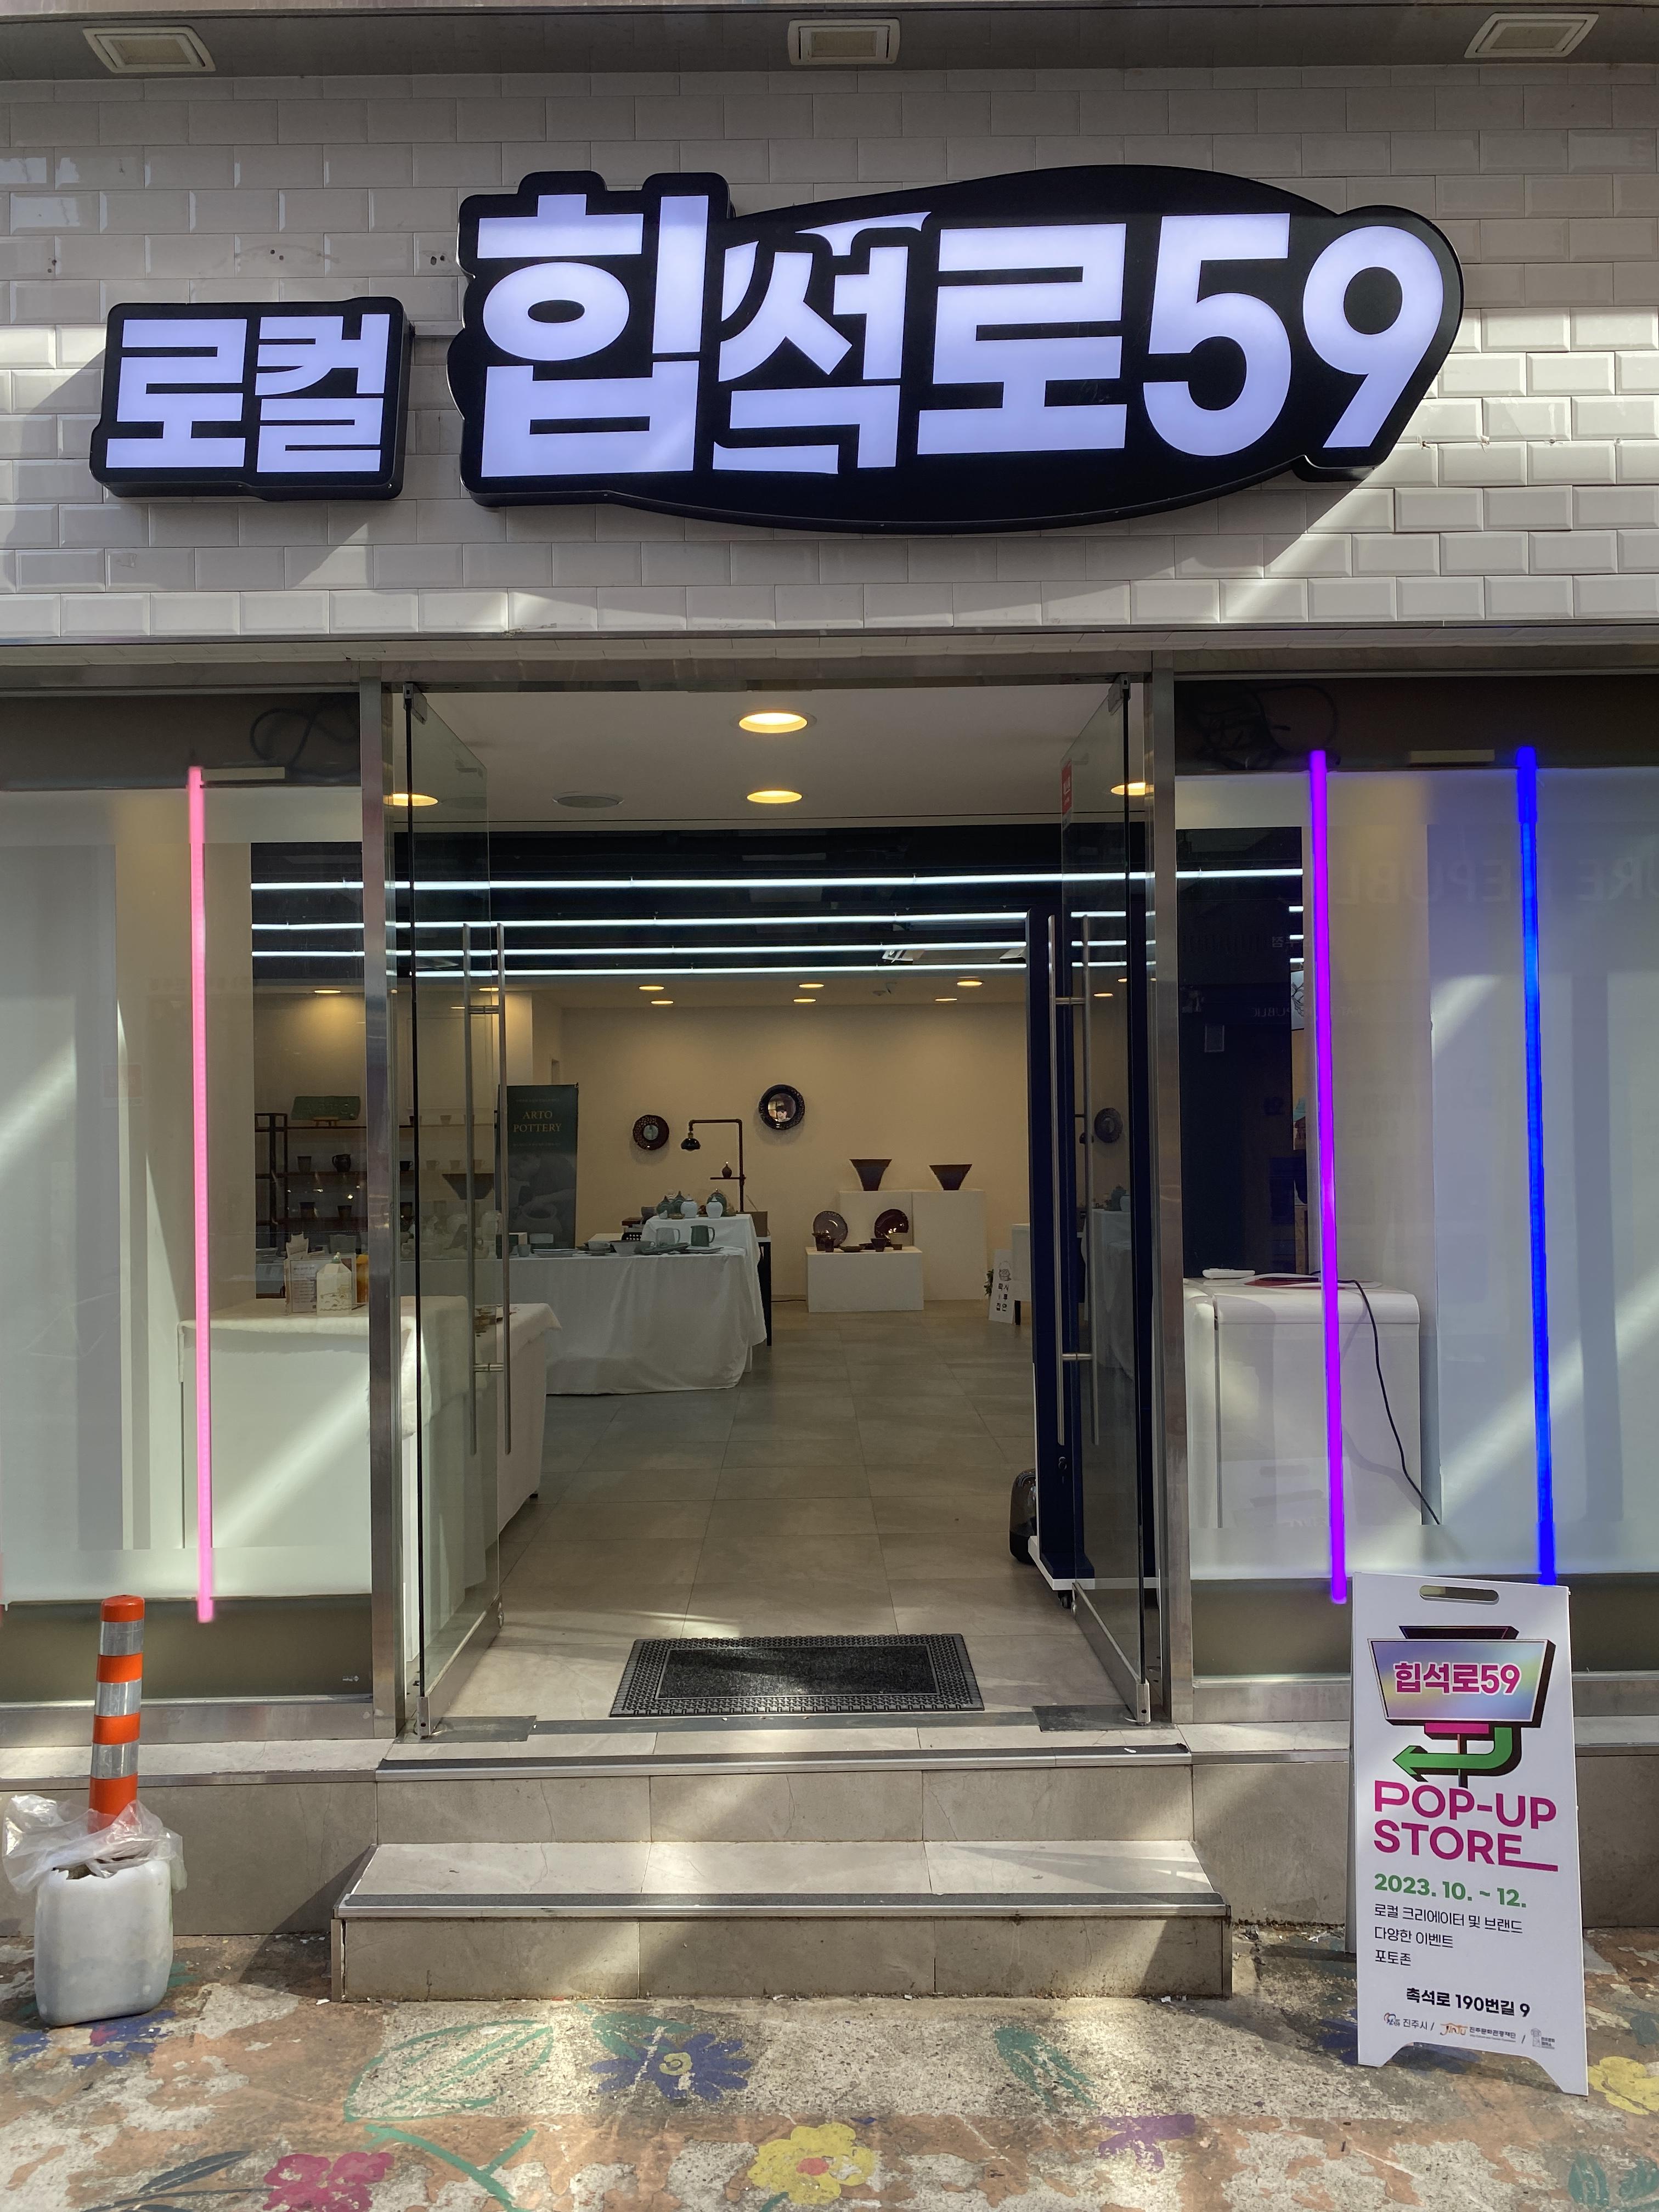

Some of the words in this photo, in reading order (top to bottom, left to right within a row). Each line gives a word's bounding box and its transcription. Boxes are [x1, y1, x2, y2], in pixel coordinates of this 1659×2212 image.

[106, 313, 390, 472] 로컬
[477, 194, 1444, 477] 힙석로59
[513, 1123, 562, 1133] POTTERY
[522, 1110, 553, 1120] ARTO
[1394, 1662, 1521, 1695] 힙석로59
[1374, 1780, 1556, 1829] POP-UP
[1374, 1819, 1558, 1871] STORE
[1374, 1873, 1436, 1897] 2023.
[1442, 1881, 1472, 1901] 10.
[1497, 1887, 1527, 1908] 12.
[1374, 1904, 1398, 1918] 로컬
[1402, 1907, 1464, 1926] 크리에이터
[1469, 1915, 1481, 1928] 및
[1485, 1917, 1523, 1934] 브랜드
[1375, 1926, 1413, 1943] 다양한
[1416, 1932, 1454, 1948] 이벤트
[1375, 1949, 1412, 1966] 포토존
[1407, 1988, 1451, 2007] 촉석로
[1455, 1994, 1515, 2017] 190번길
[1520, 2002, 1531, 2018] 9
[1403, 2018, 1427, 2030] 진주시
